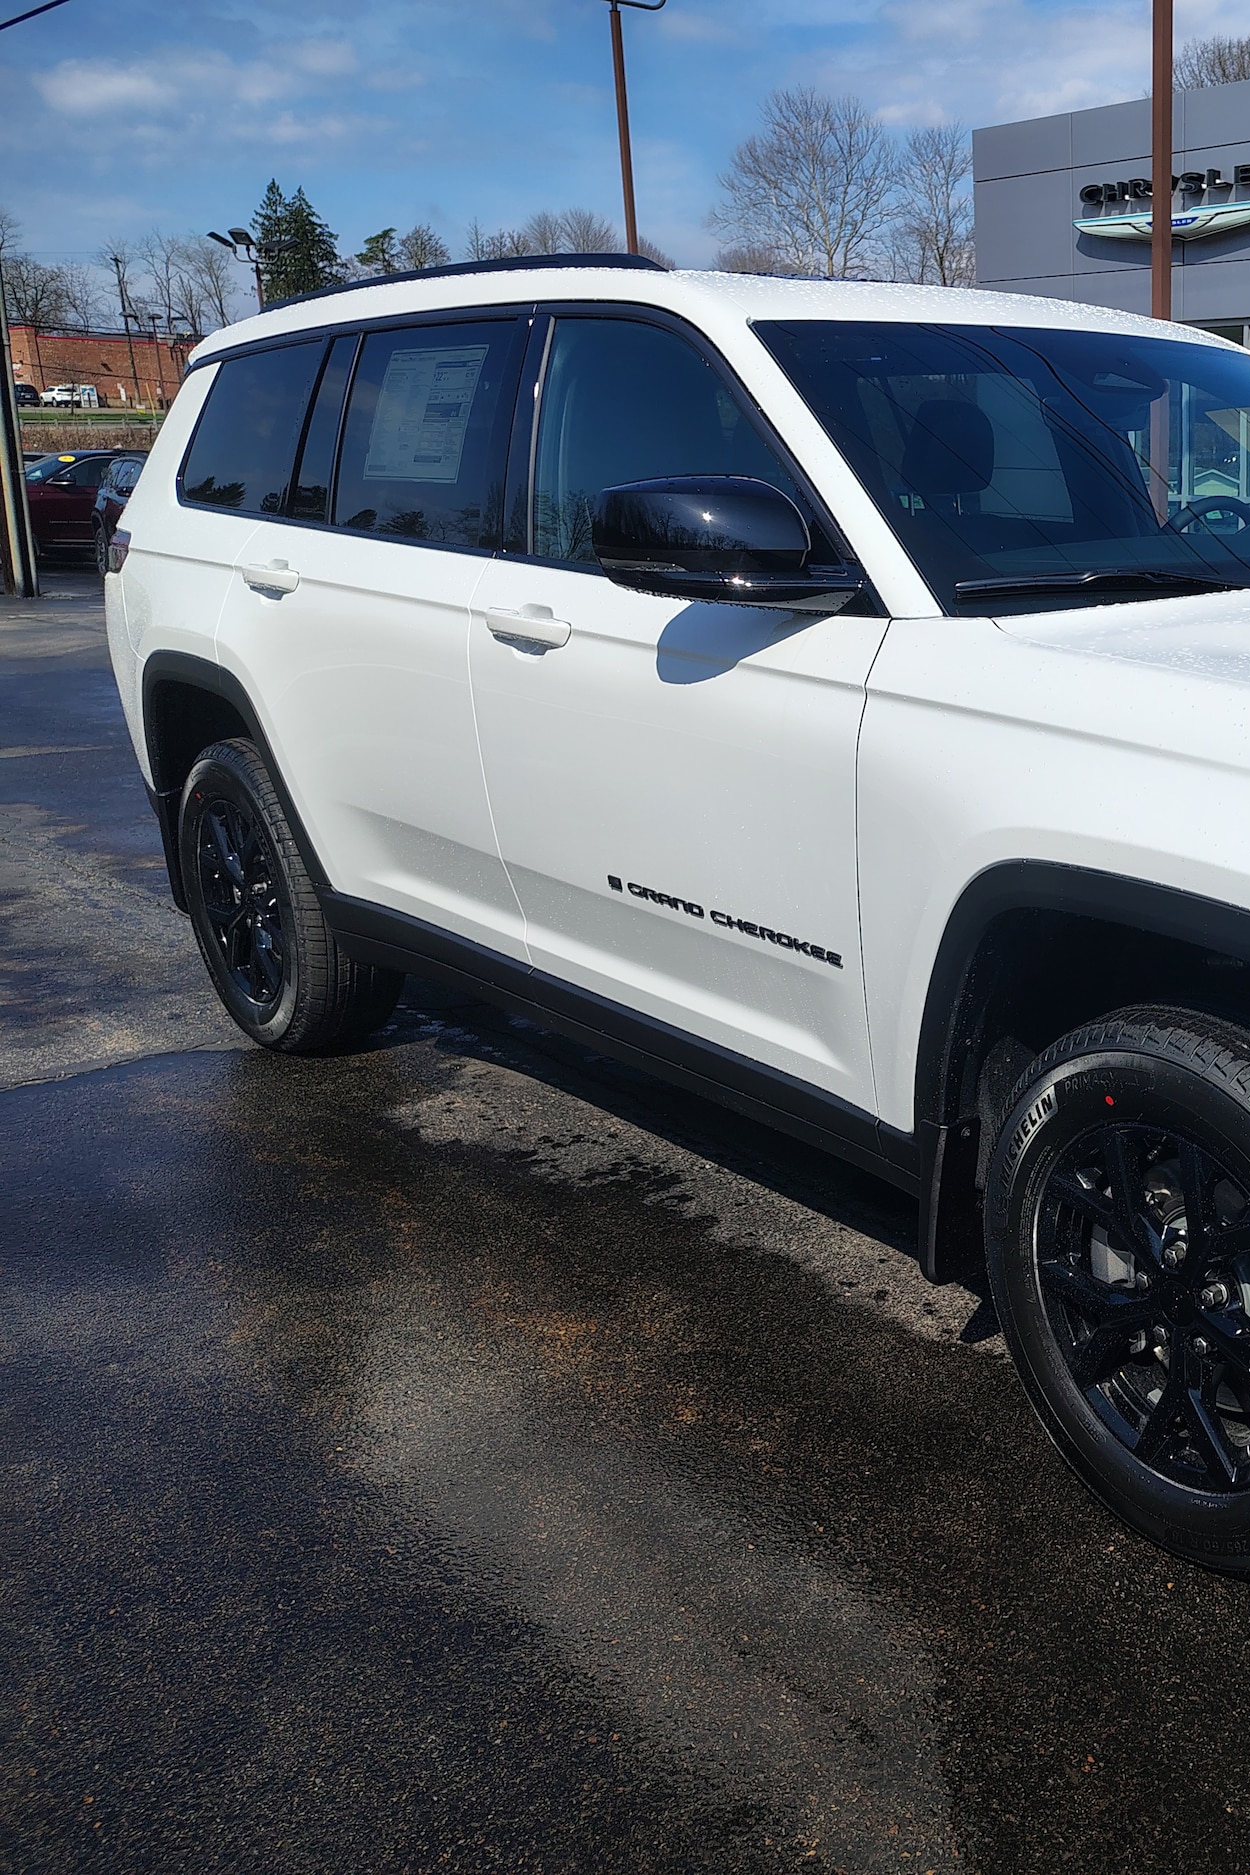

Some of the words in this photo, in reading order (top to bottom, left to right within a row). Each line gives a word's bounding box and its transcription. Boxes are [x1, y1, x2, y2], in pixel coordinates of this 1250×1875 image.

[627, 882, 704, 919] GRAND
[710, 909, 844, 969] CHEROKEE
[1001, 1093, 1054, 1189] MICHELIN
